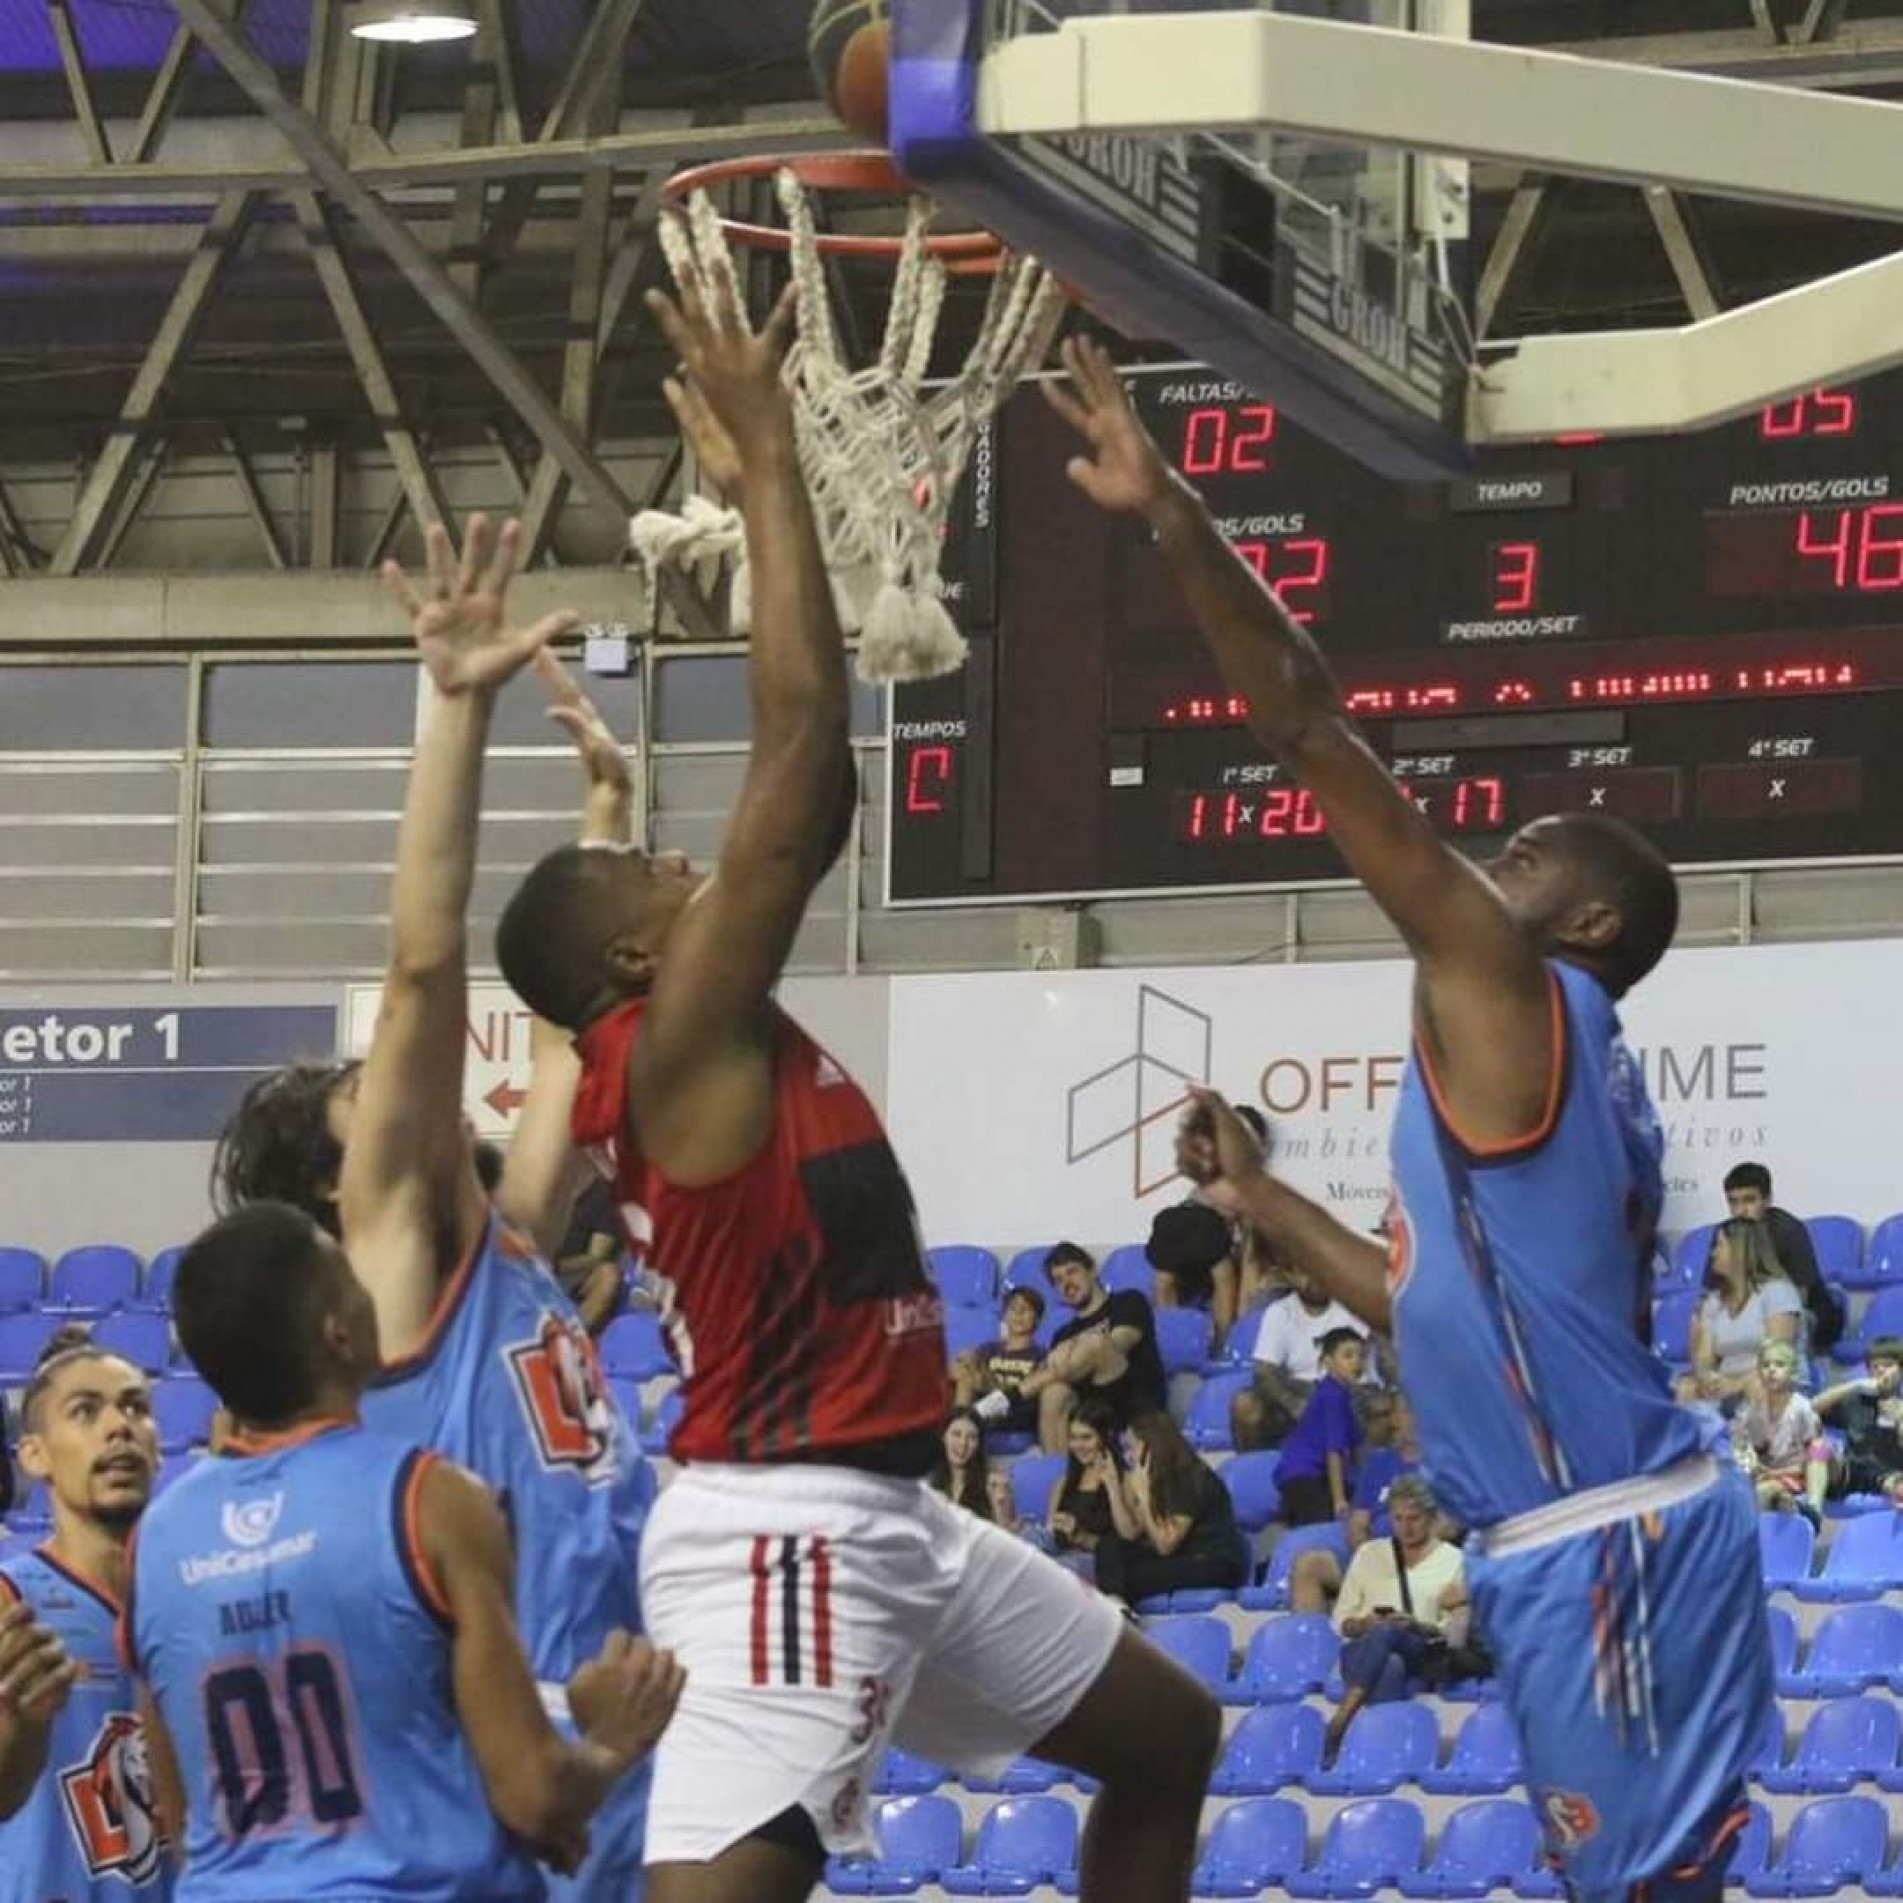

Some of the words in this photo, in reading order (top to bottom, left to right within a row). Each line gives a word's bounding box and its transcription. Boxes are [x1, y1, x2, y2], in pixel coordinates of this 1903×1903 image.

[1159, 379, 1248, 403] FALTAS/
[1184, 406, 1275, 473] 02
[1477, 480, 1543, 502] TEMPO
[1730, 477, 1890, 505] PONTOS/GOLS
[1796, 504, 1903, 591] 46
[1494, 544, 1539, 612] 3
[894, 720, 967, 740] TEMPOS
[1772, 738, 1813, 757] SET
[1240, 764, 1279, 783] SET
[1418, 755, 1455, 773] SET
[1592, 747, 1631, 766] SET
[1190, 795, 1238, 837] 11
[1453, 778, 1502, 824] 17
[2, 1015, 134, 1062] etor
[154, 1013, 181, 1060] 1
[1260, 1056, 1405, 1114] OFF
[1639, 1042, 1768, 1101] IME
[1284, 1126, 1380, 1161] mbie
[200, 1640, 372, 1843] 00
